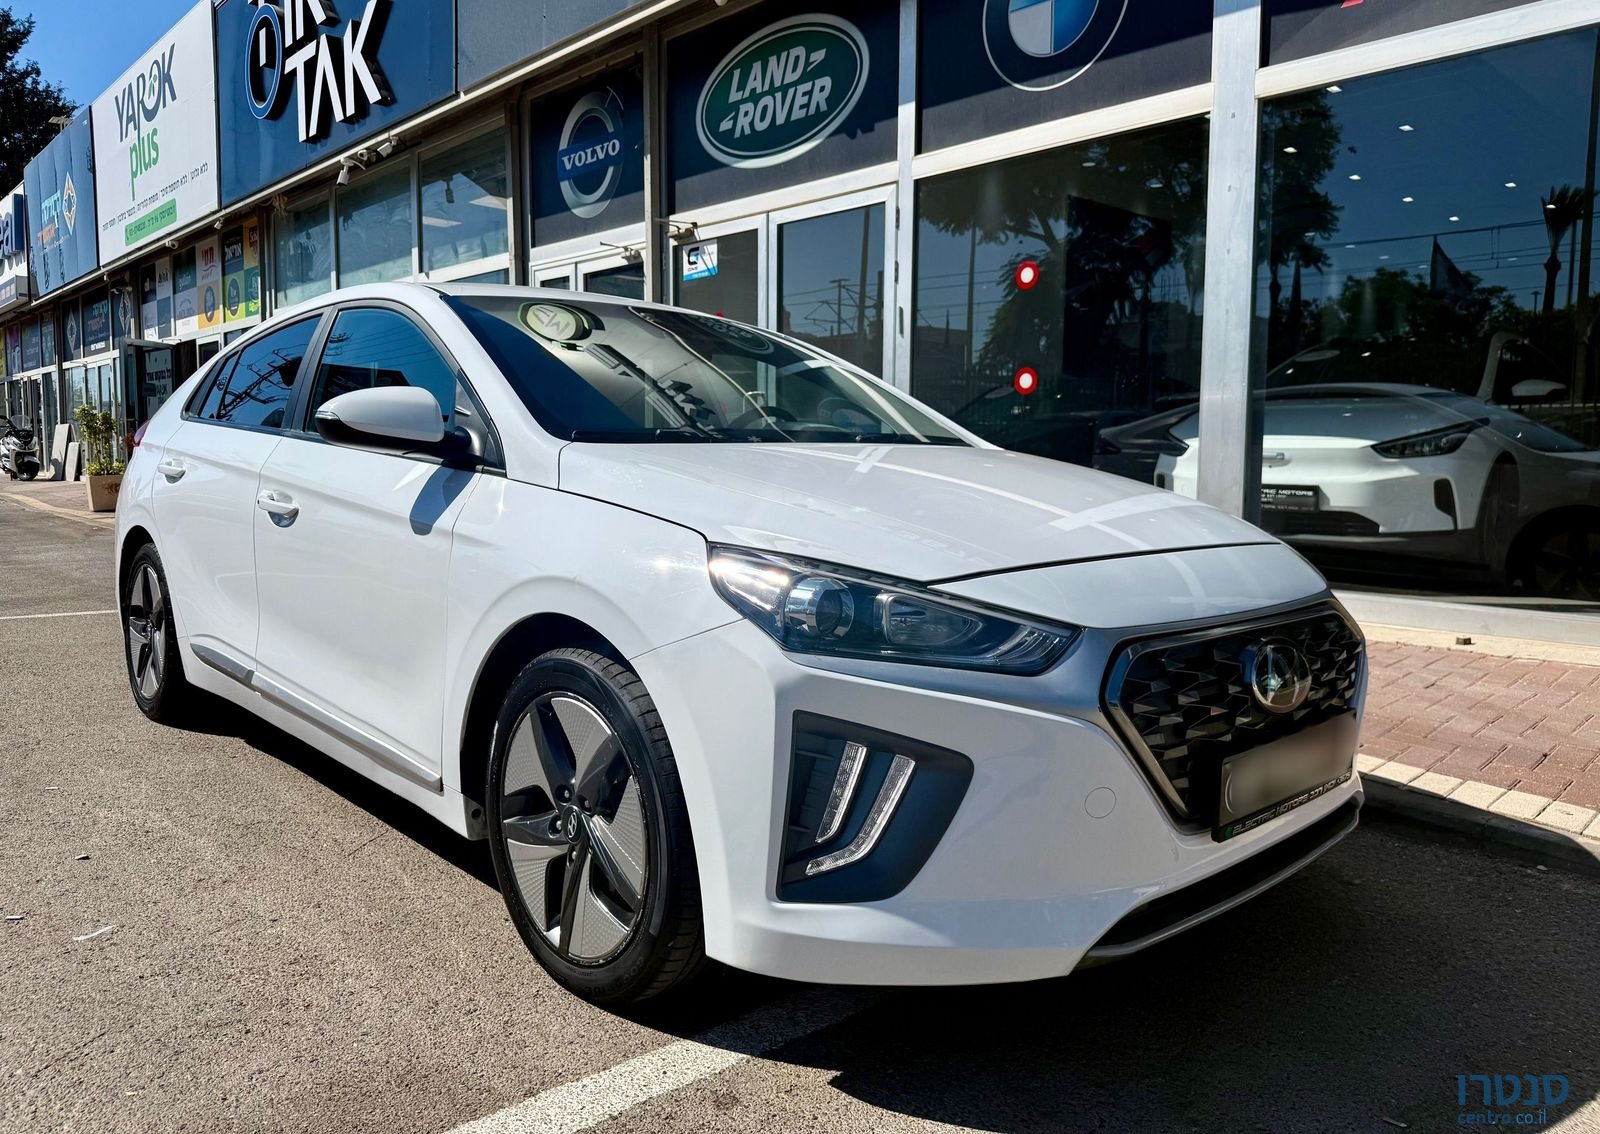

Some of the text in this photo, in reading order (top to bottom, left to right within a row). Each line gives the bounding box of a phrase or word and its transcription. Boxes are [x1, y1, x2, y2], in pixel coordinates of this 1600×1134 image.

[114, 43, 177, 143] YAROK
[284, 0, 382, 143] TAK
[728, 46, 806, 103] LAND
[734, 76, 832, 139] ROVER
[128, 127, 160, 202] plus
[561, 139, 620, 170] VOLVO
